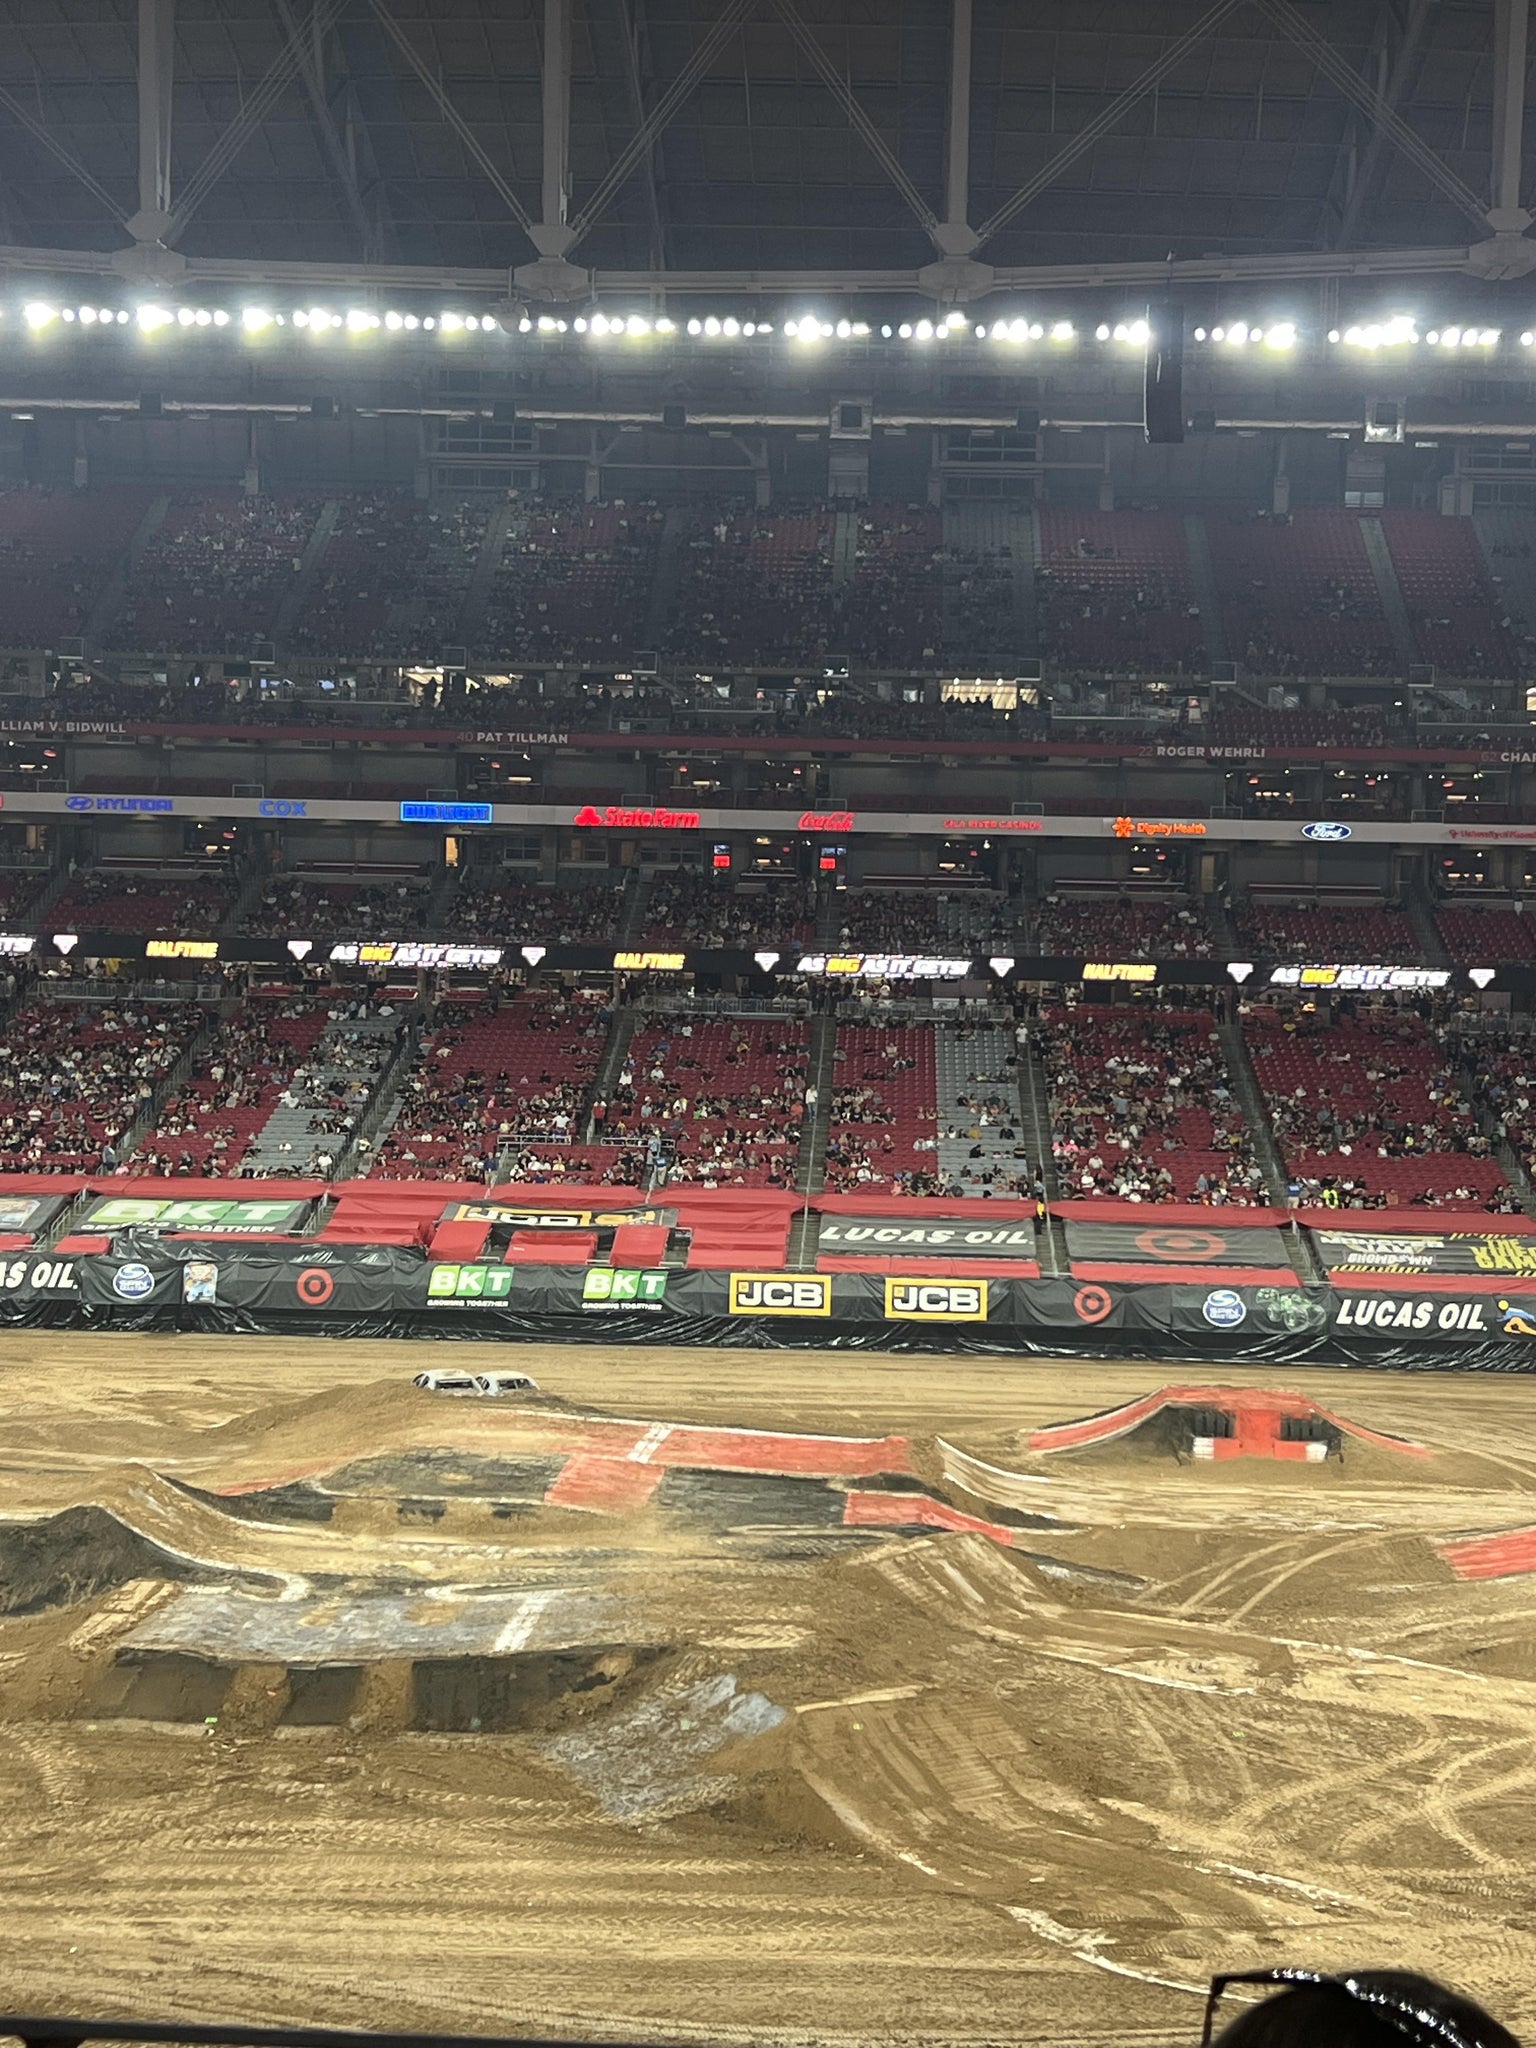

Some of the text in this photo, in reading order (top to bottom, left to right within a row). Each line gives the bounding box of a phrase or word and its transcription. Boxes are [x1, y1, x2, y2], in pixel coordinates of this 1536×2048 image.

[66, 722, 127, 733] BIDWILL
[477, 732, 503, 742] PAT
[507, 733, 568, 744] TILLMAN
[1157, 746, 1205, 757] ROGER
[1209, 747, 1266, 758] WEHRLI
[96, 798, 174, 812] HYUNDAI
[259, 800, 307, 816] COX
[1137, 822, 1206, 836] Dignity Health
[1310, 824, 1343, 838] Ford
[145, 941, 219, 958] HALFTIME
[330, 945, 358, 960] AS
[359, 946, 394, 961] BIG
[394, 946, 422, 962] AS
[422, 947, 443, 962] IT
[613, 952, 686, 970] HALFTIME
[797, 957, 826, 972] AS
[826, 958, 861, 973] BIG
[860, 958, 889, 973] AS
[889, 959, 912, 973] IT
[1083, 963, 1158, 981] HALFTIME
[1270, 967, 1300, 983] AS
[1300, 968, 1337, 984] BIG
[1336, 969, 1367, 985] AS
[1366, 969, 1391, 985] IT
[102, 1201, 290, 1222] BKT
[819, 1226, 955, 1244] LUCAS
[429, 1269, 512, 1293] BKT
[584, 1272, 666, 1296] BKT
[738, 1281, 823, 1308] JCB
[893, 1286, 979, 1313] JCB
[466, 1300, 509, 1308] TOGETHER
[620, 1303, 662, 1311] TOGETHER
[1336, 1299, 1434, 1329] LUCAS
